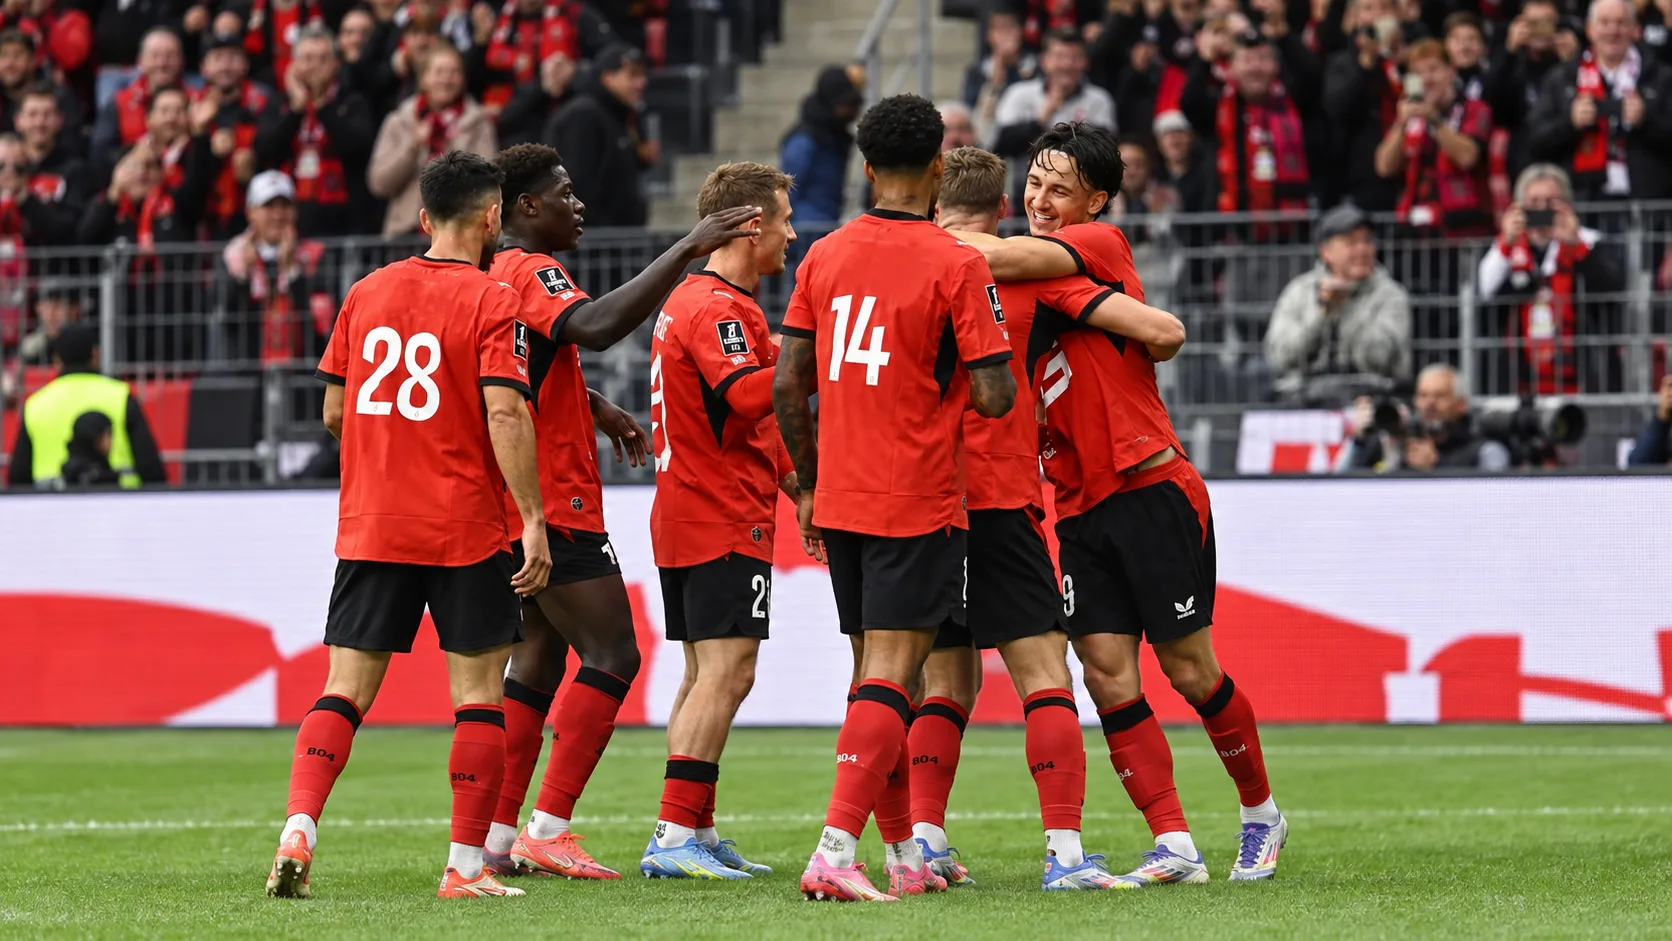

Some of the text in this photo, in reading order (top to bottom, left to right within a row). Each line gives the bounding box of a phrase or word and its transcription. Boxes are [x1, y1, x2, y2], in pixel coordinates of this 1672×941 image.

[356, 326, 442, 421] 28
[829, 294, 890, 386] 14
[1062, 574, 1075, 617] 9
